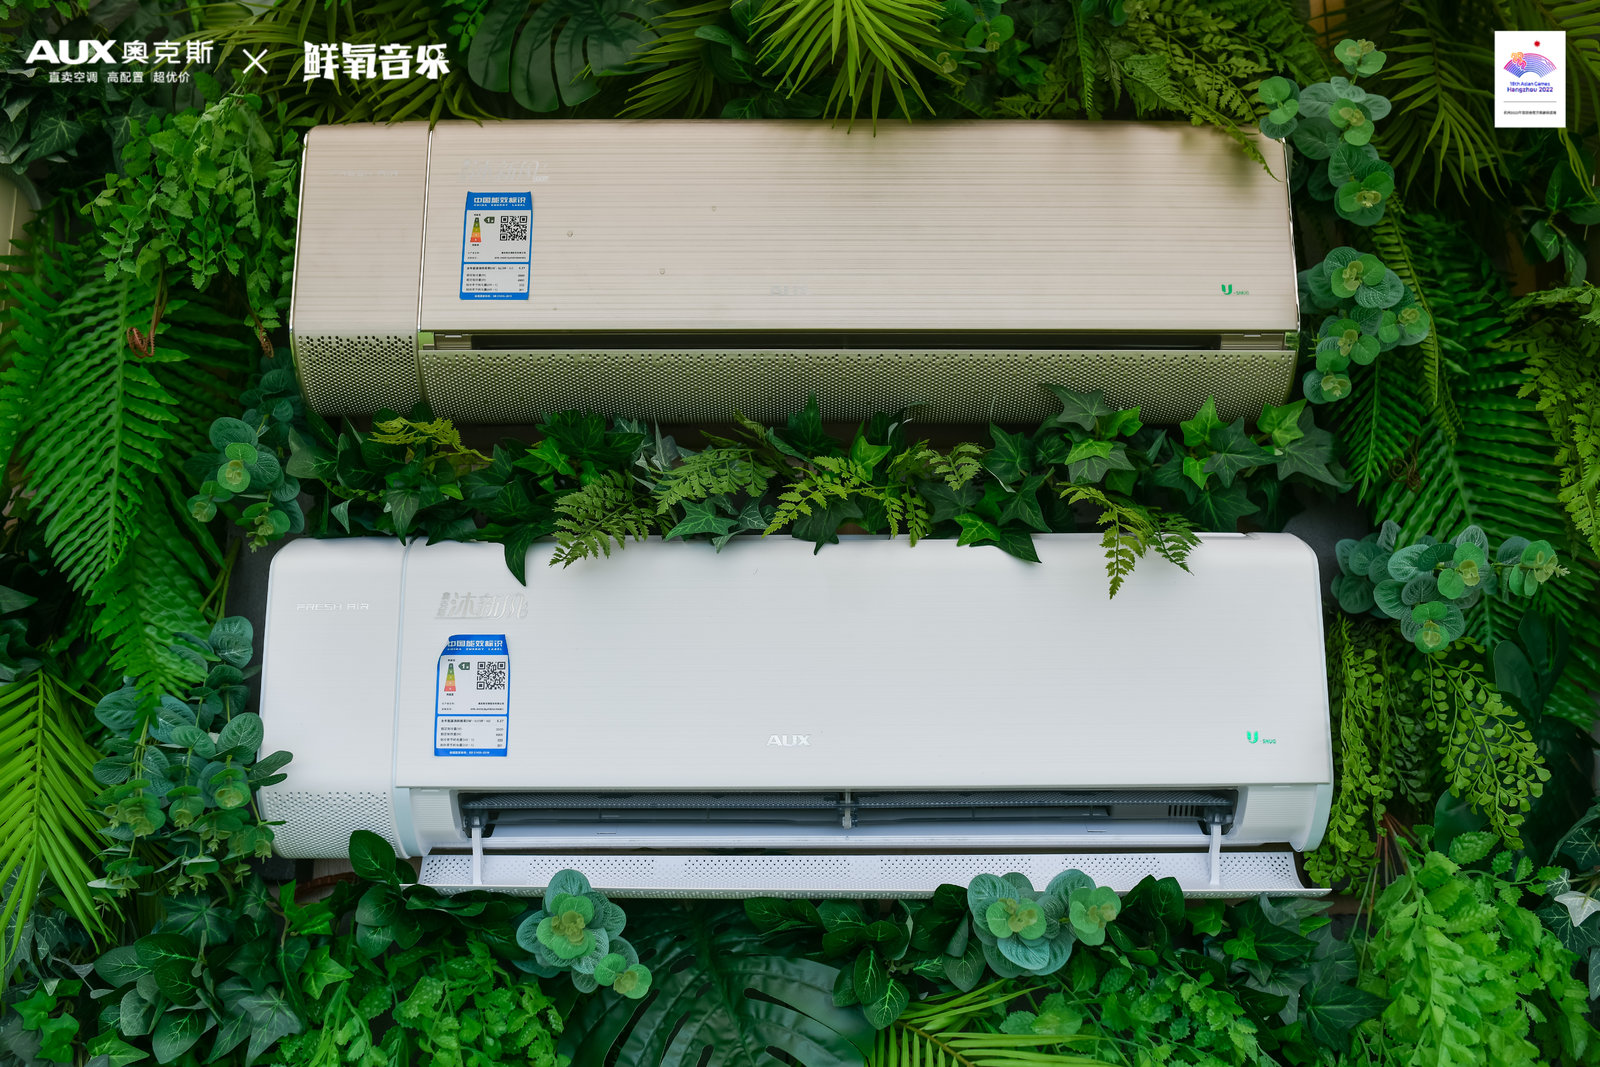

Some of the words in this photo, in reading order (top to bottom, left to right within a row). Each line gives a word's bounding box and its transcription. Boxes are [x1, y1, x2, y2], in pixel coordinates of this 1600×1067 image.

[473, 196, 526, 204] 中国能效标识
[296, 603, 342, 611] FRESH
[347, 603, 369, 611] AIR
[447, 639, 503, 648] 中国能效标识
[766, 734, 812, 747] AUX
